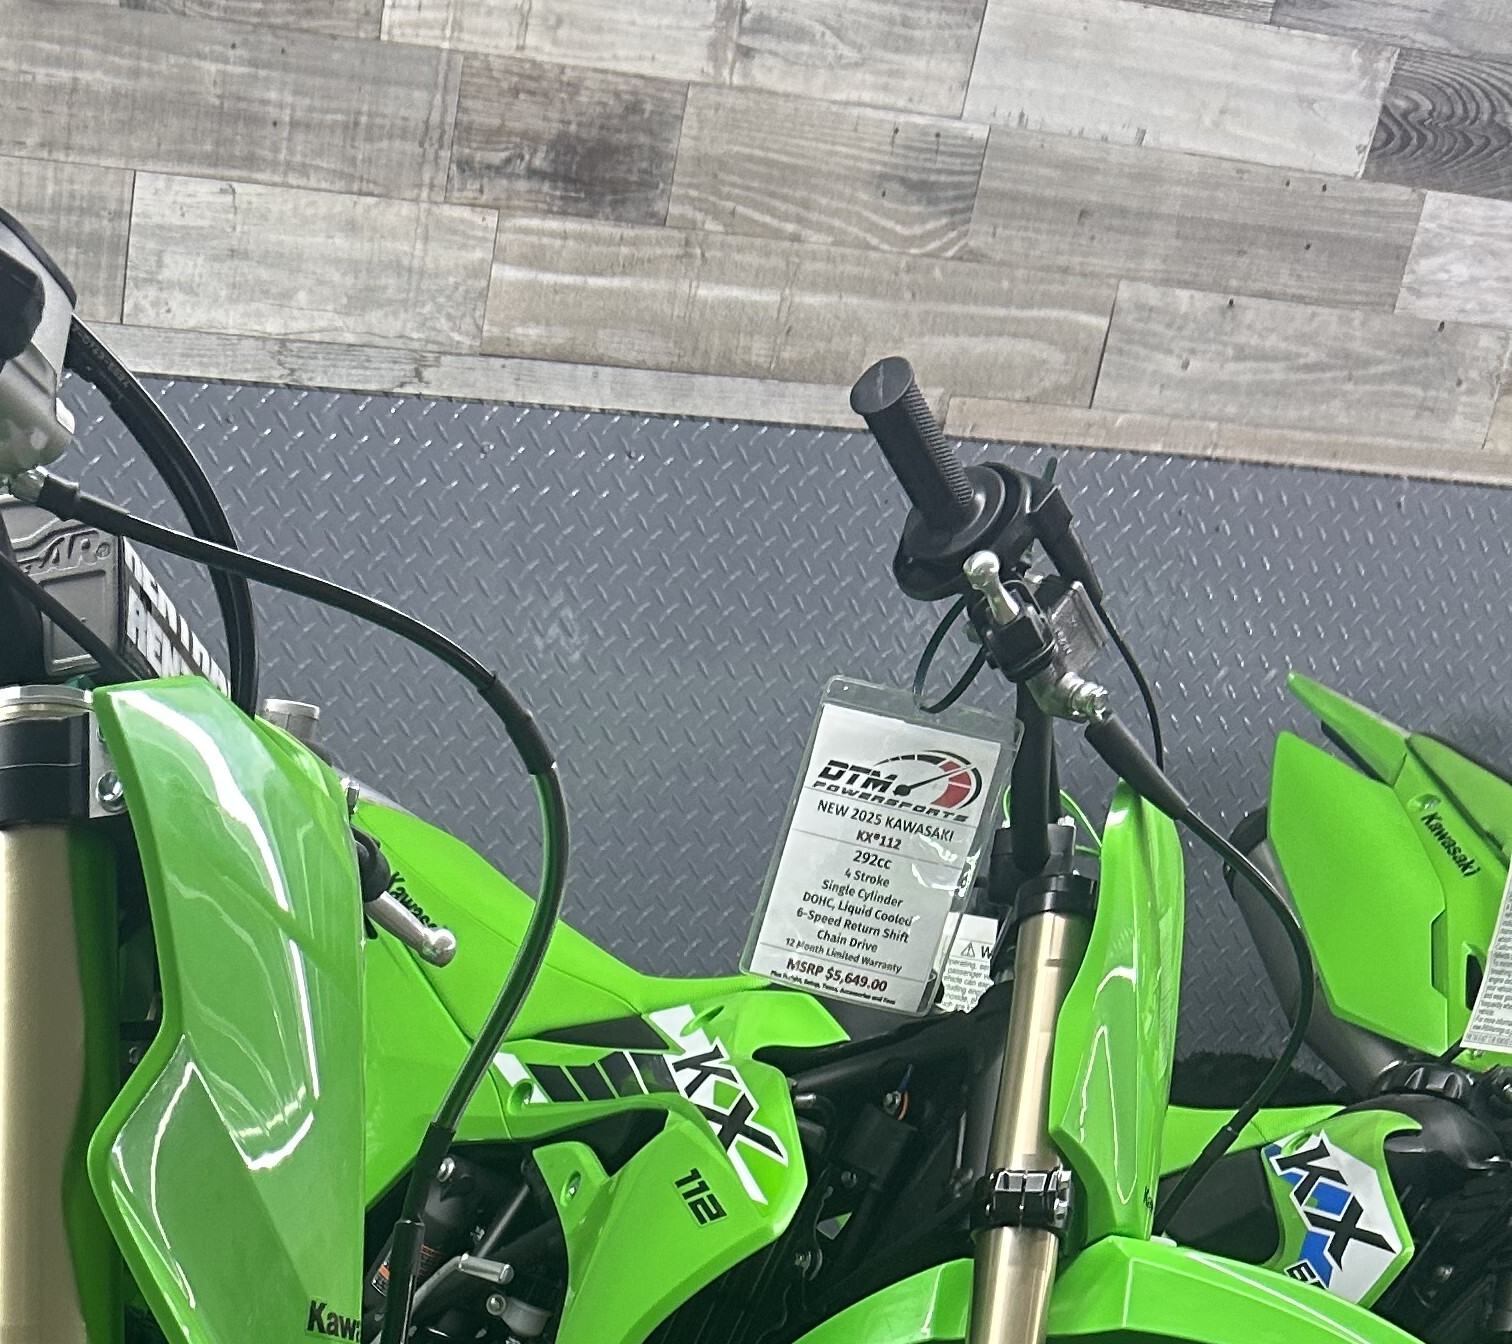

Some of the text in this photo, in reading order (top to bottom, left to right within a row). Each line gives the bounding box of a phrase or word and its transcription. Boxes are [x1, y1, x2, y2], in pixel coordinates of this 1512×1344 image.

[817, 760, 898, 793] DTM
[812, 781, 969, 822] POWERSPORTS
[817, 799, 954, 842] NEW 2025 KAWASAKI
[853, 850, 893, 870] 292cc
[1420, 812, 1481, 877] Kawasaki
[822, 879, 903, 908] Single Cylinder
[844, 868, 890, 888] 4 Stroke
[796, 907, 910, 943] 6-Speed Return Shift
[802, 891, 913, 927] DOHC, Liquid Cooled
[786, 938, 903, 974] 12 Month Limited Warranty
[817, 929, 878, 953] Chain Drive
[786, 957, 888, 992] MSRP $5,649.00
[672, 1044, 789, 1165] KX
[674, 1169, 726, 1225] 112
[1276, 1138, 1397, 1272] KX
